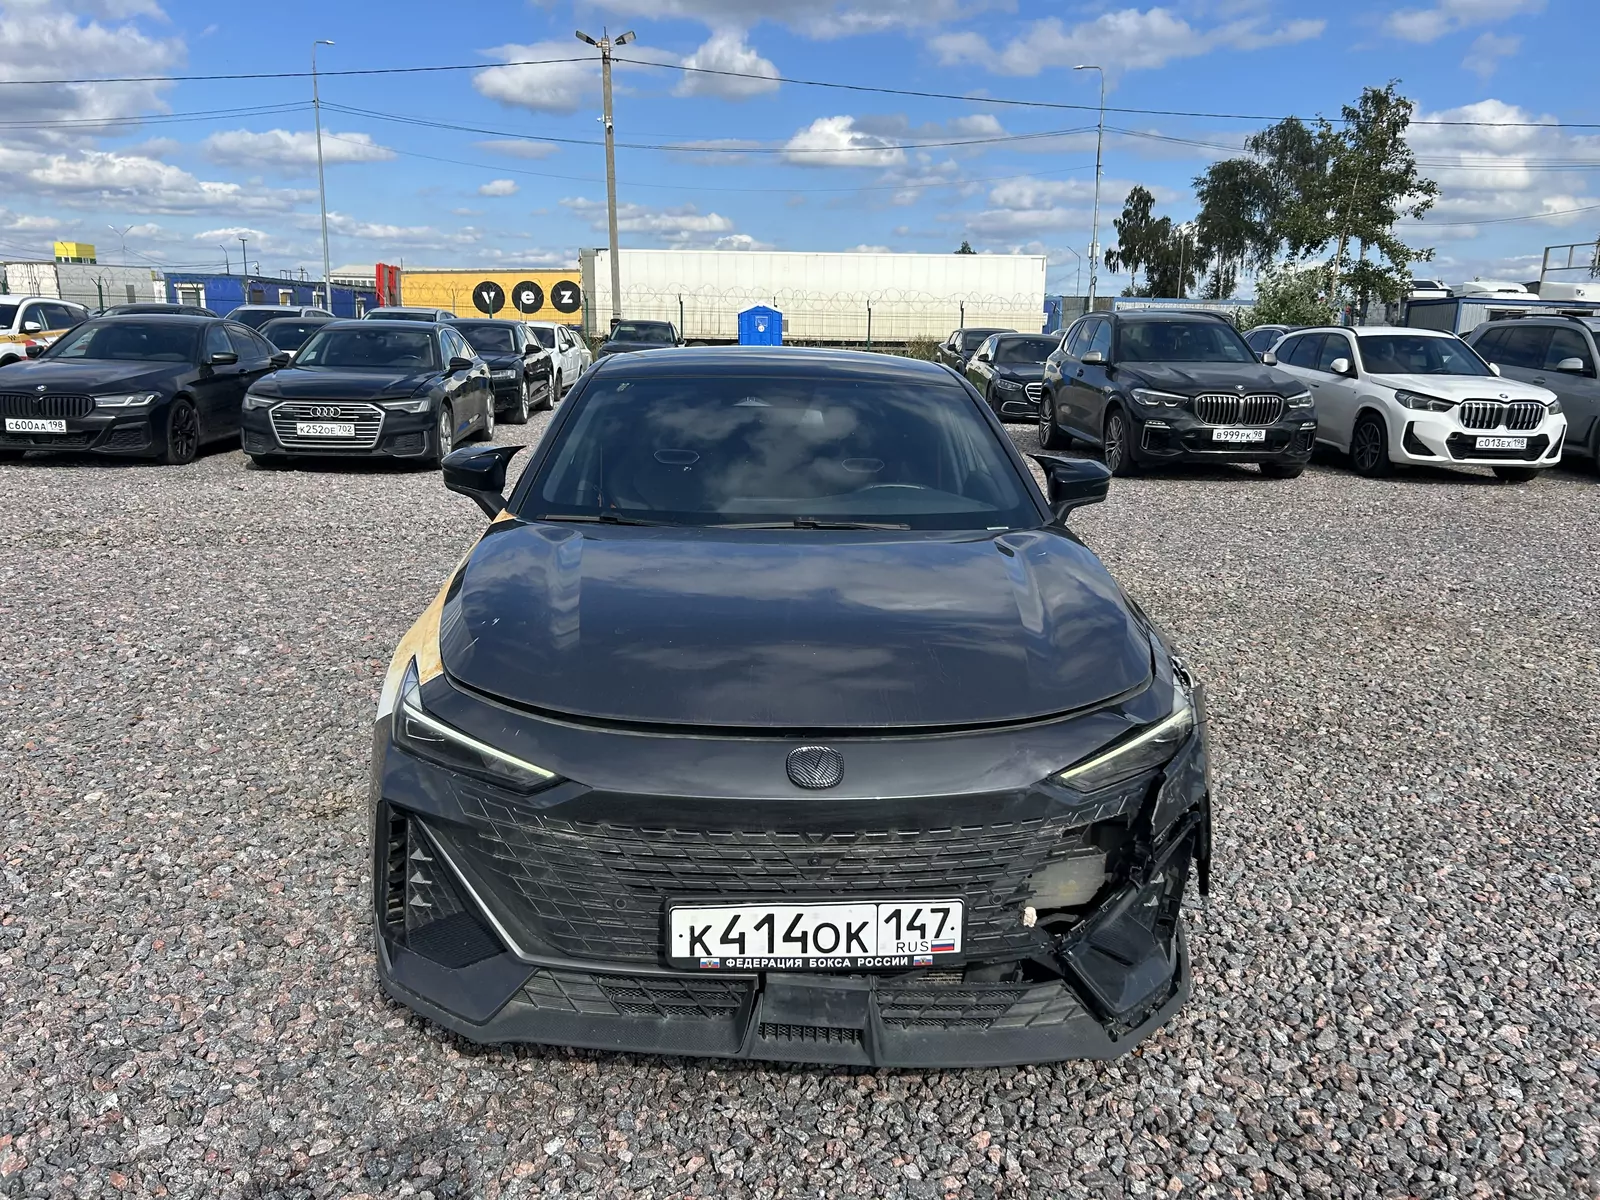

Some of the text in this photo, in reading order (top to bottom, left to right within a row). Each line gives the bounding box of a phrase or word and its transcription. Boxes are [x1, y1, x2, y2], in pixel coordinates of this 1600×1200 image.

[8, 420, 63, 431] С600АА 198
[337, 425, 352, 433] 702
[1253, 430, 1263, 438] 98
[1512, 438, 1525, 446] 198
[689, 908, 951, 956] К414ОК 147
[896, 941, 929, 953] RUS
[725, 956, 908, 969] ФЕДЕРАЦИЯ БОКСА РОССИИ
